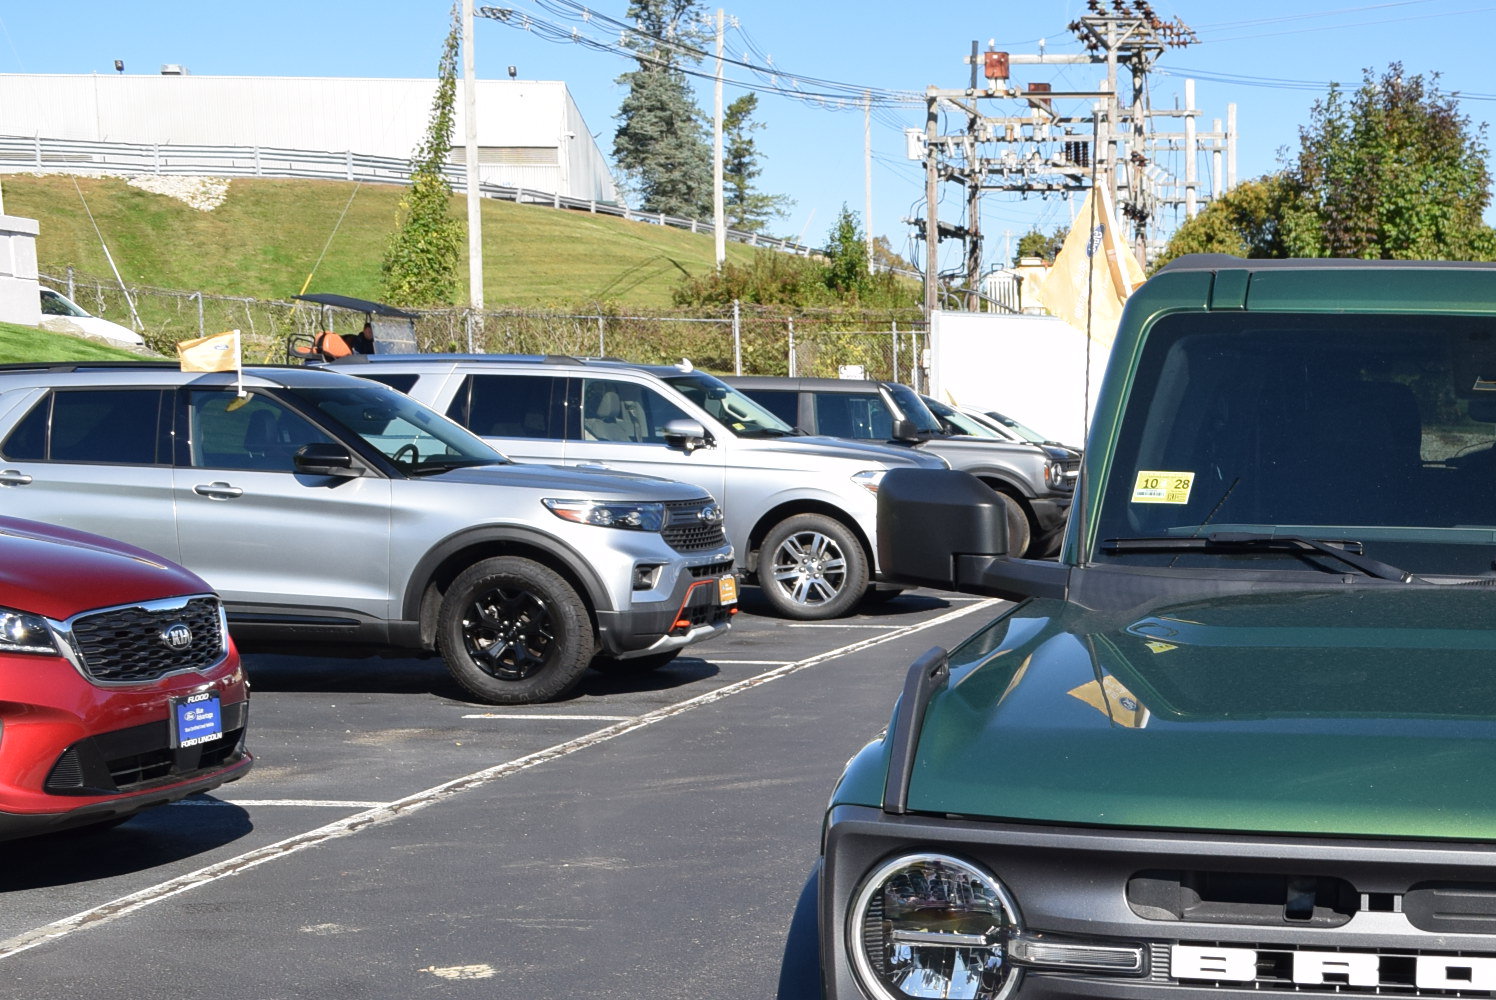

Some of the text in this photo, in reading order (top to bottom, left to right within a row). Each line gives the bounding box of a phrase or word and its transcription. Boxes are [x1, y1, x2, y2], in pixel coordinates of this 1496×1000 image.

[1142, 478, 1190, 490] 10 28
[188, 693, 209, 703] FLOOD
[181, 732, 222, 748] FORD LINCOLN
